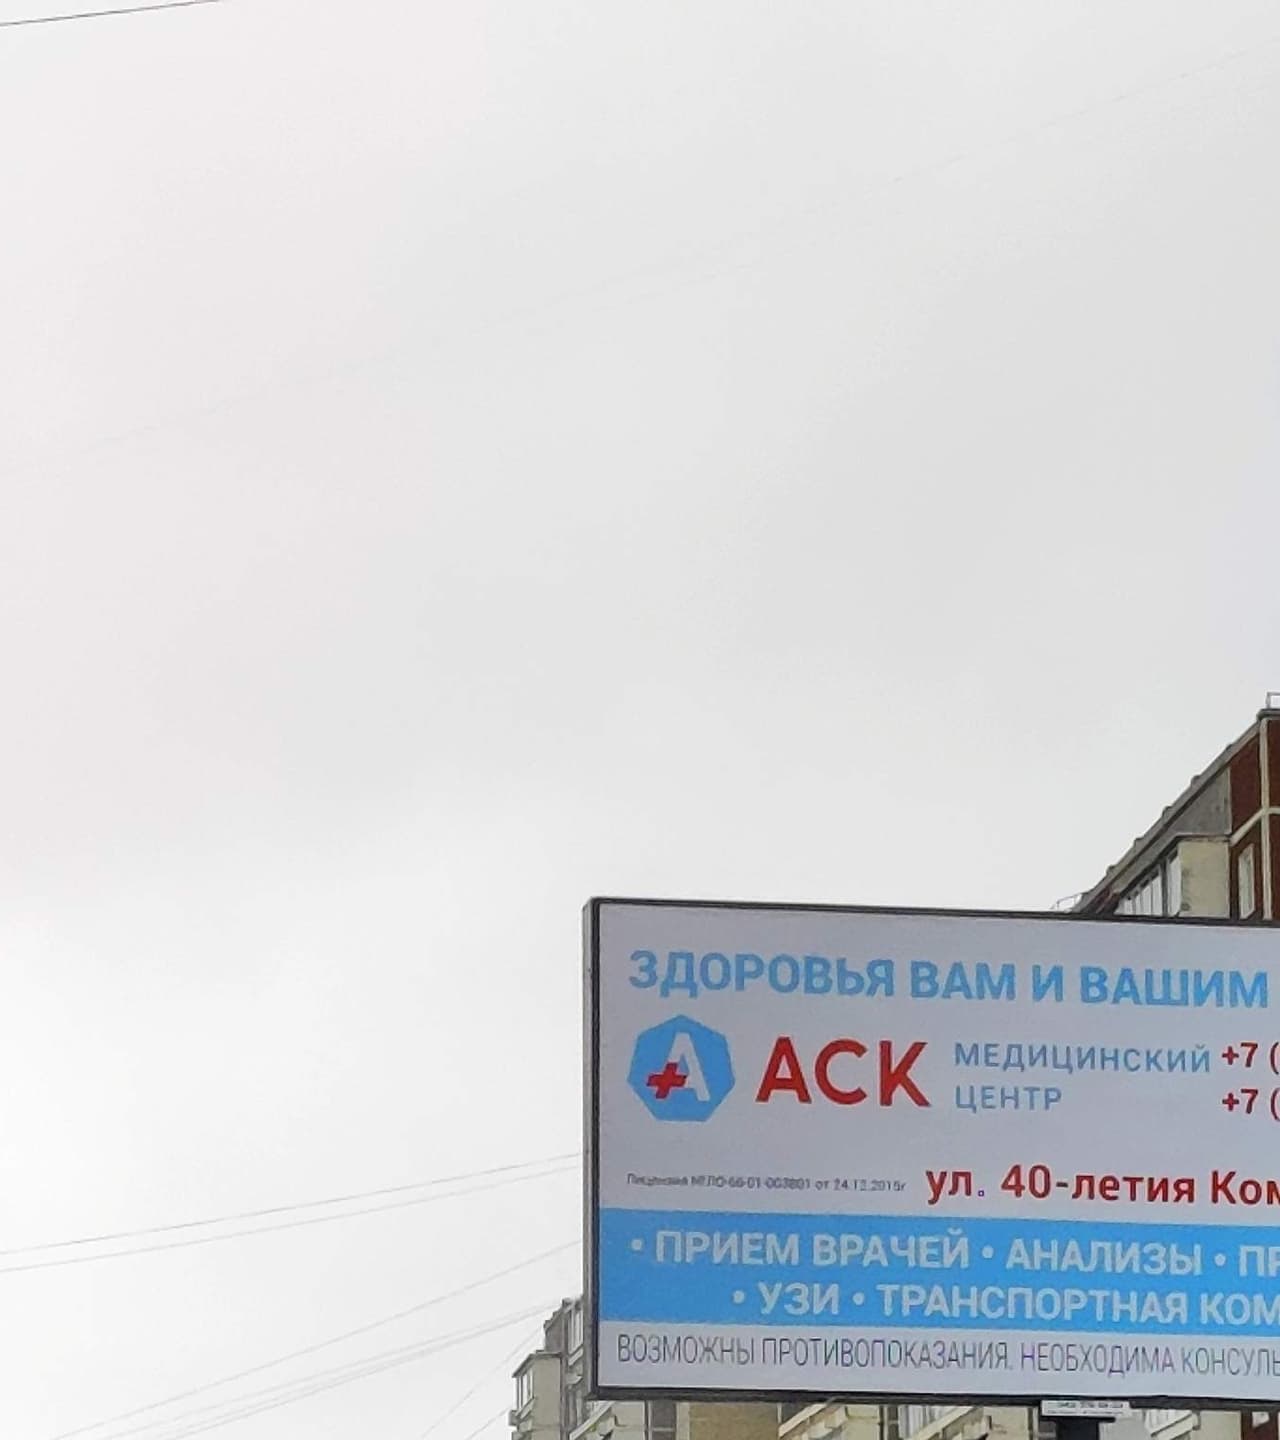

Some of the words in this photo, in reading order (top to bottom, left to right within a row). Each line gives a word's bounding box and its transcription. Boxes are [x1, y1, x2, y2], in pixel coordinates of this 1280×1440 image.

[629, 949, 894, 998] ЗДОРОВЬЯ
[911, 961, 1016, 1000] ВАМ
[1032, 965, 1065, 1003] И
[1080, 966, 1268, 1009] ВАШИМ
[755, 1036, 931, 1107] АСК
[954, 1042, 1211, 1074] МЕДИЦИНСКИЙ
[1221, 1042, 1259, 1069] +7
[955, 1085, 1062, 1113] ЦЕНТР
[1221, 1089, 1259, 1116] +7
[925, 1170, 985, 1205] ул.
[1001, 1164, 1195, 1204] 40-летия
[655, 1231, 800, 1265] ПРИЕМ
[812, 1230, 970, 1269] ВРАЧЕЙ
[1005, 1239, 1202, 1276] АНАЛИЗЫ
[758, 1283, 841, 1316] УЗИ
[878, 1284, 1188, 1324] ТРАНСПОРТНАЯ
[617, 1334, 755, 1365] ВОЗМОЖНЫ
[1020, 1343, 1176, 1378] НЕОБХОДИМА
